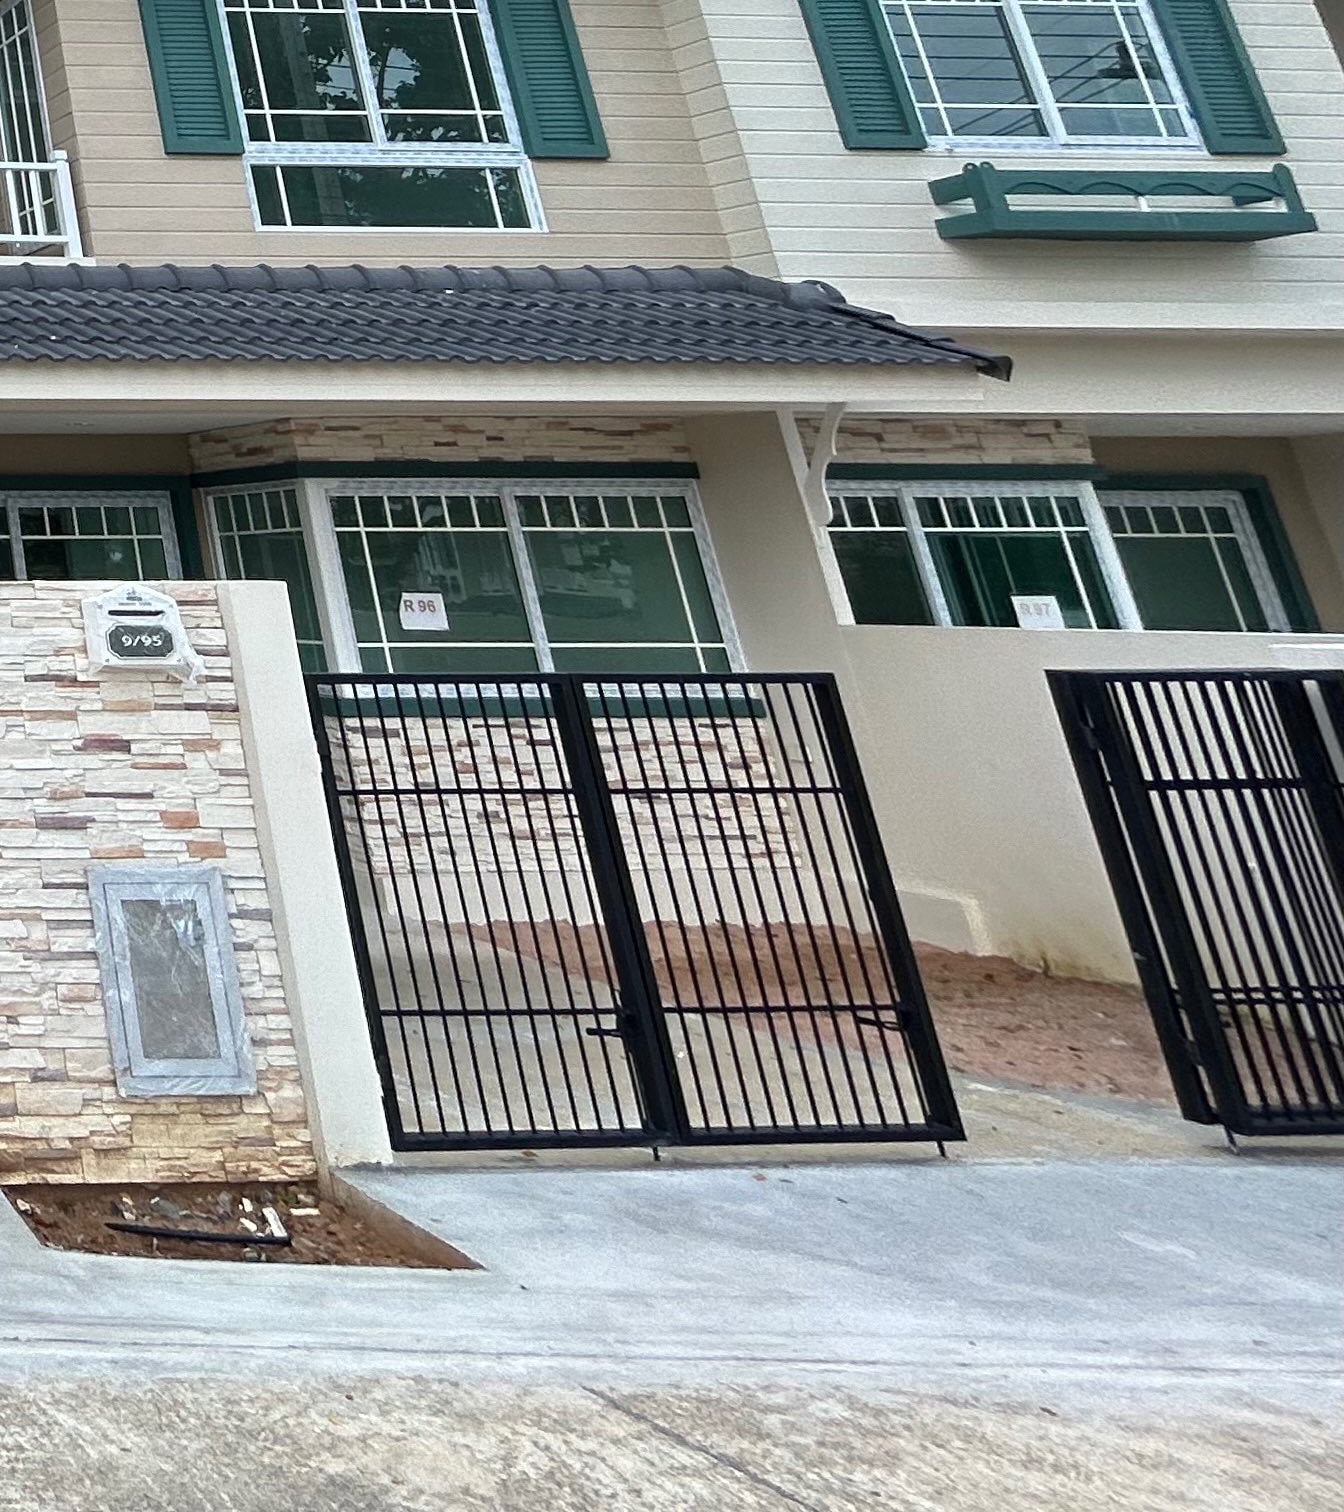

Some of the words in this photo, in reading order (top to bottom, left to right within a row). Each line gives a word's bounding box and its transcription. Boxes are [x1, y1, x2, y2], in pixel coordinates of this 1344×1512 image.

[403, 599, 415, 613] R
[417, 600, 437, 613] 96
[121, 634, 162, 648] 9/95
